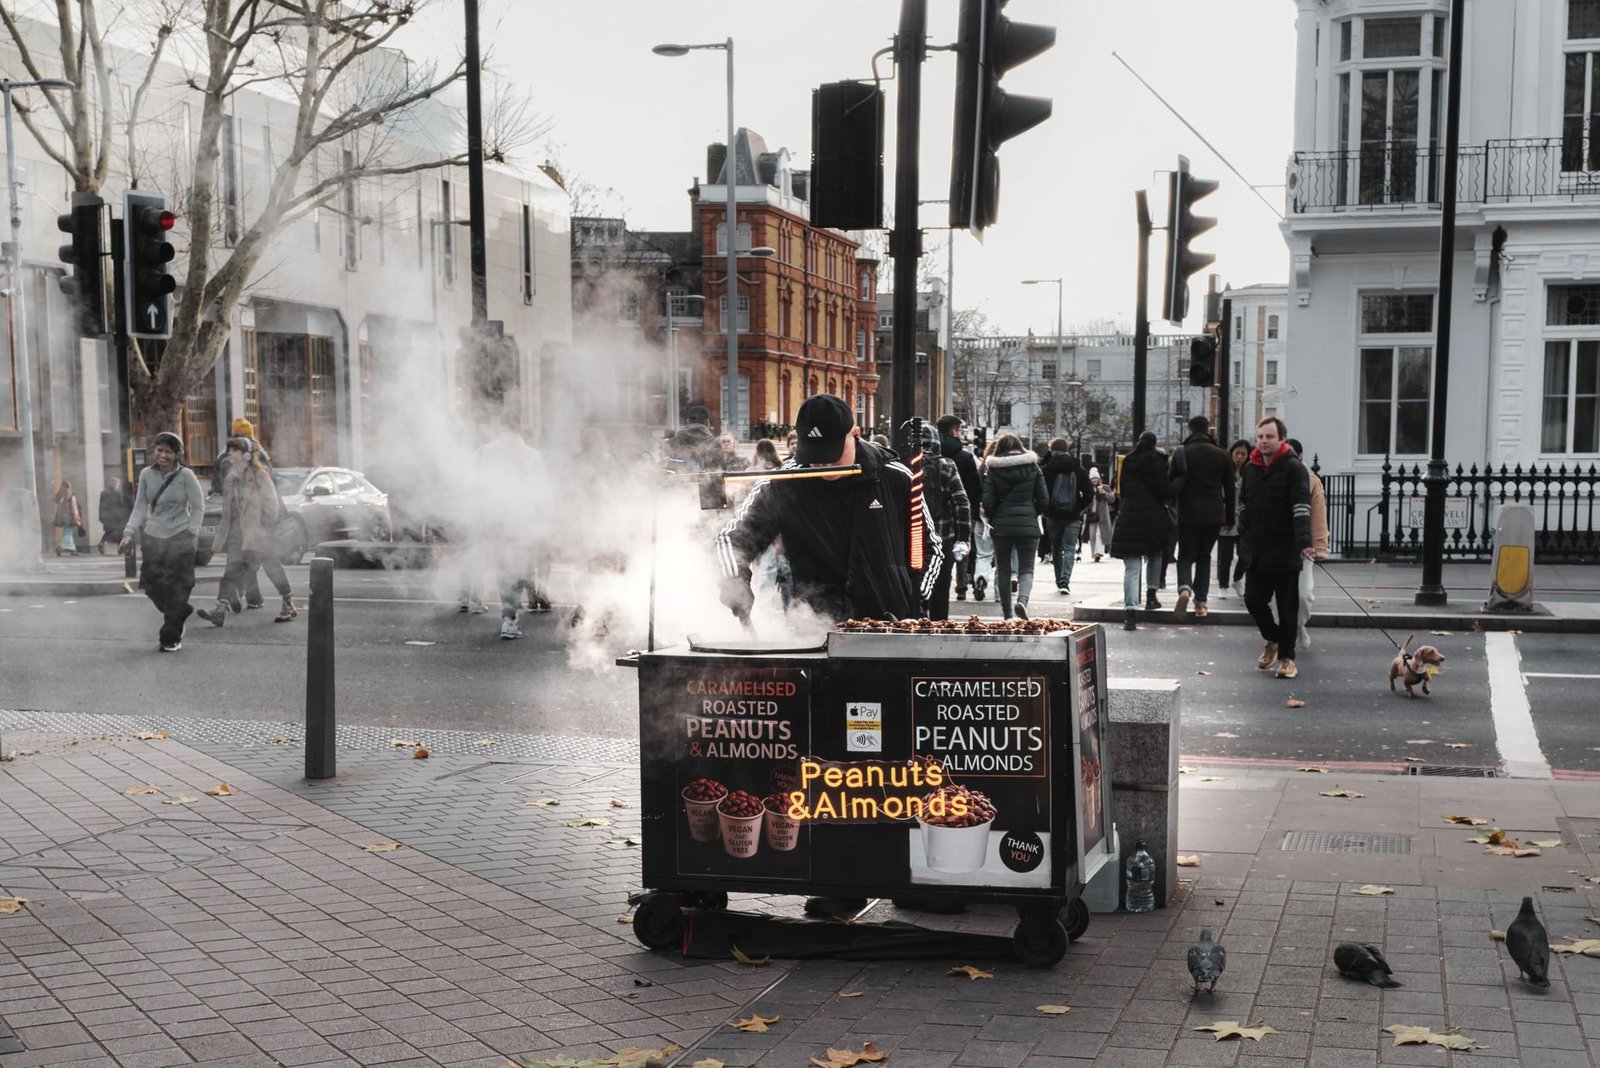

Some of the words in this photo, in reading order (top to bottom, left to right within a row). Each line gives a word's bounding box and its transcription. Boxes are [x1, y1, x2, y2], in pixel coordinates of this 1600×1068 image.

[687, 681, 796, 697] CARAMELISED
[915, 681, 1041, 698] CARAMELISED
[702, 700, 778, 716] ROASTED
[860, 706, 878, 720] Pay
[937, 704, 1020, 721] ROASTED
[686, 718, 792, 741] PEANUTS
[915, 726, 1043, 751] PEANUTS
[690, 741, 702, 757] &
[706, 742, 798, 760] ALMONDS
[941, 754, 1033, 771] ALMONDS
[801, 761, 943, 789] Peanuts
[728, 825, 753, 833] VEGAN
[1007, 837, 1040, 855] THANK
[1011, 850, 1031, 863] YOU
